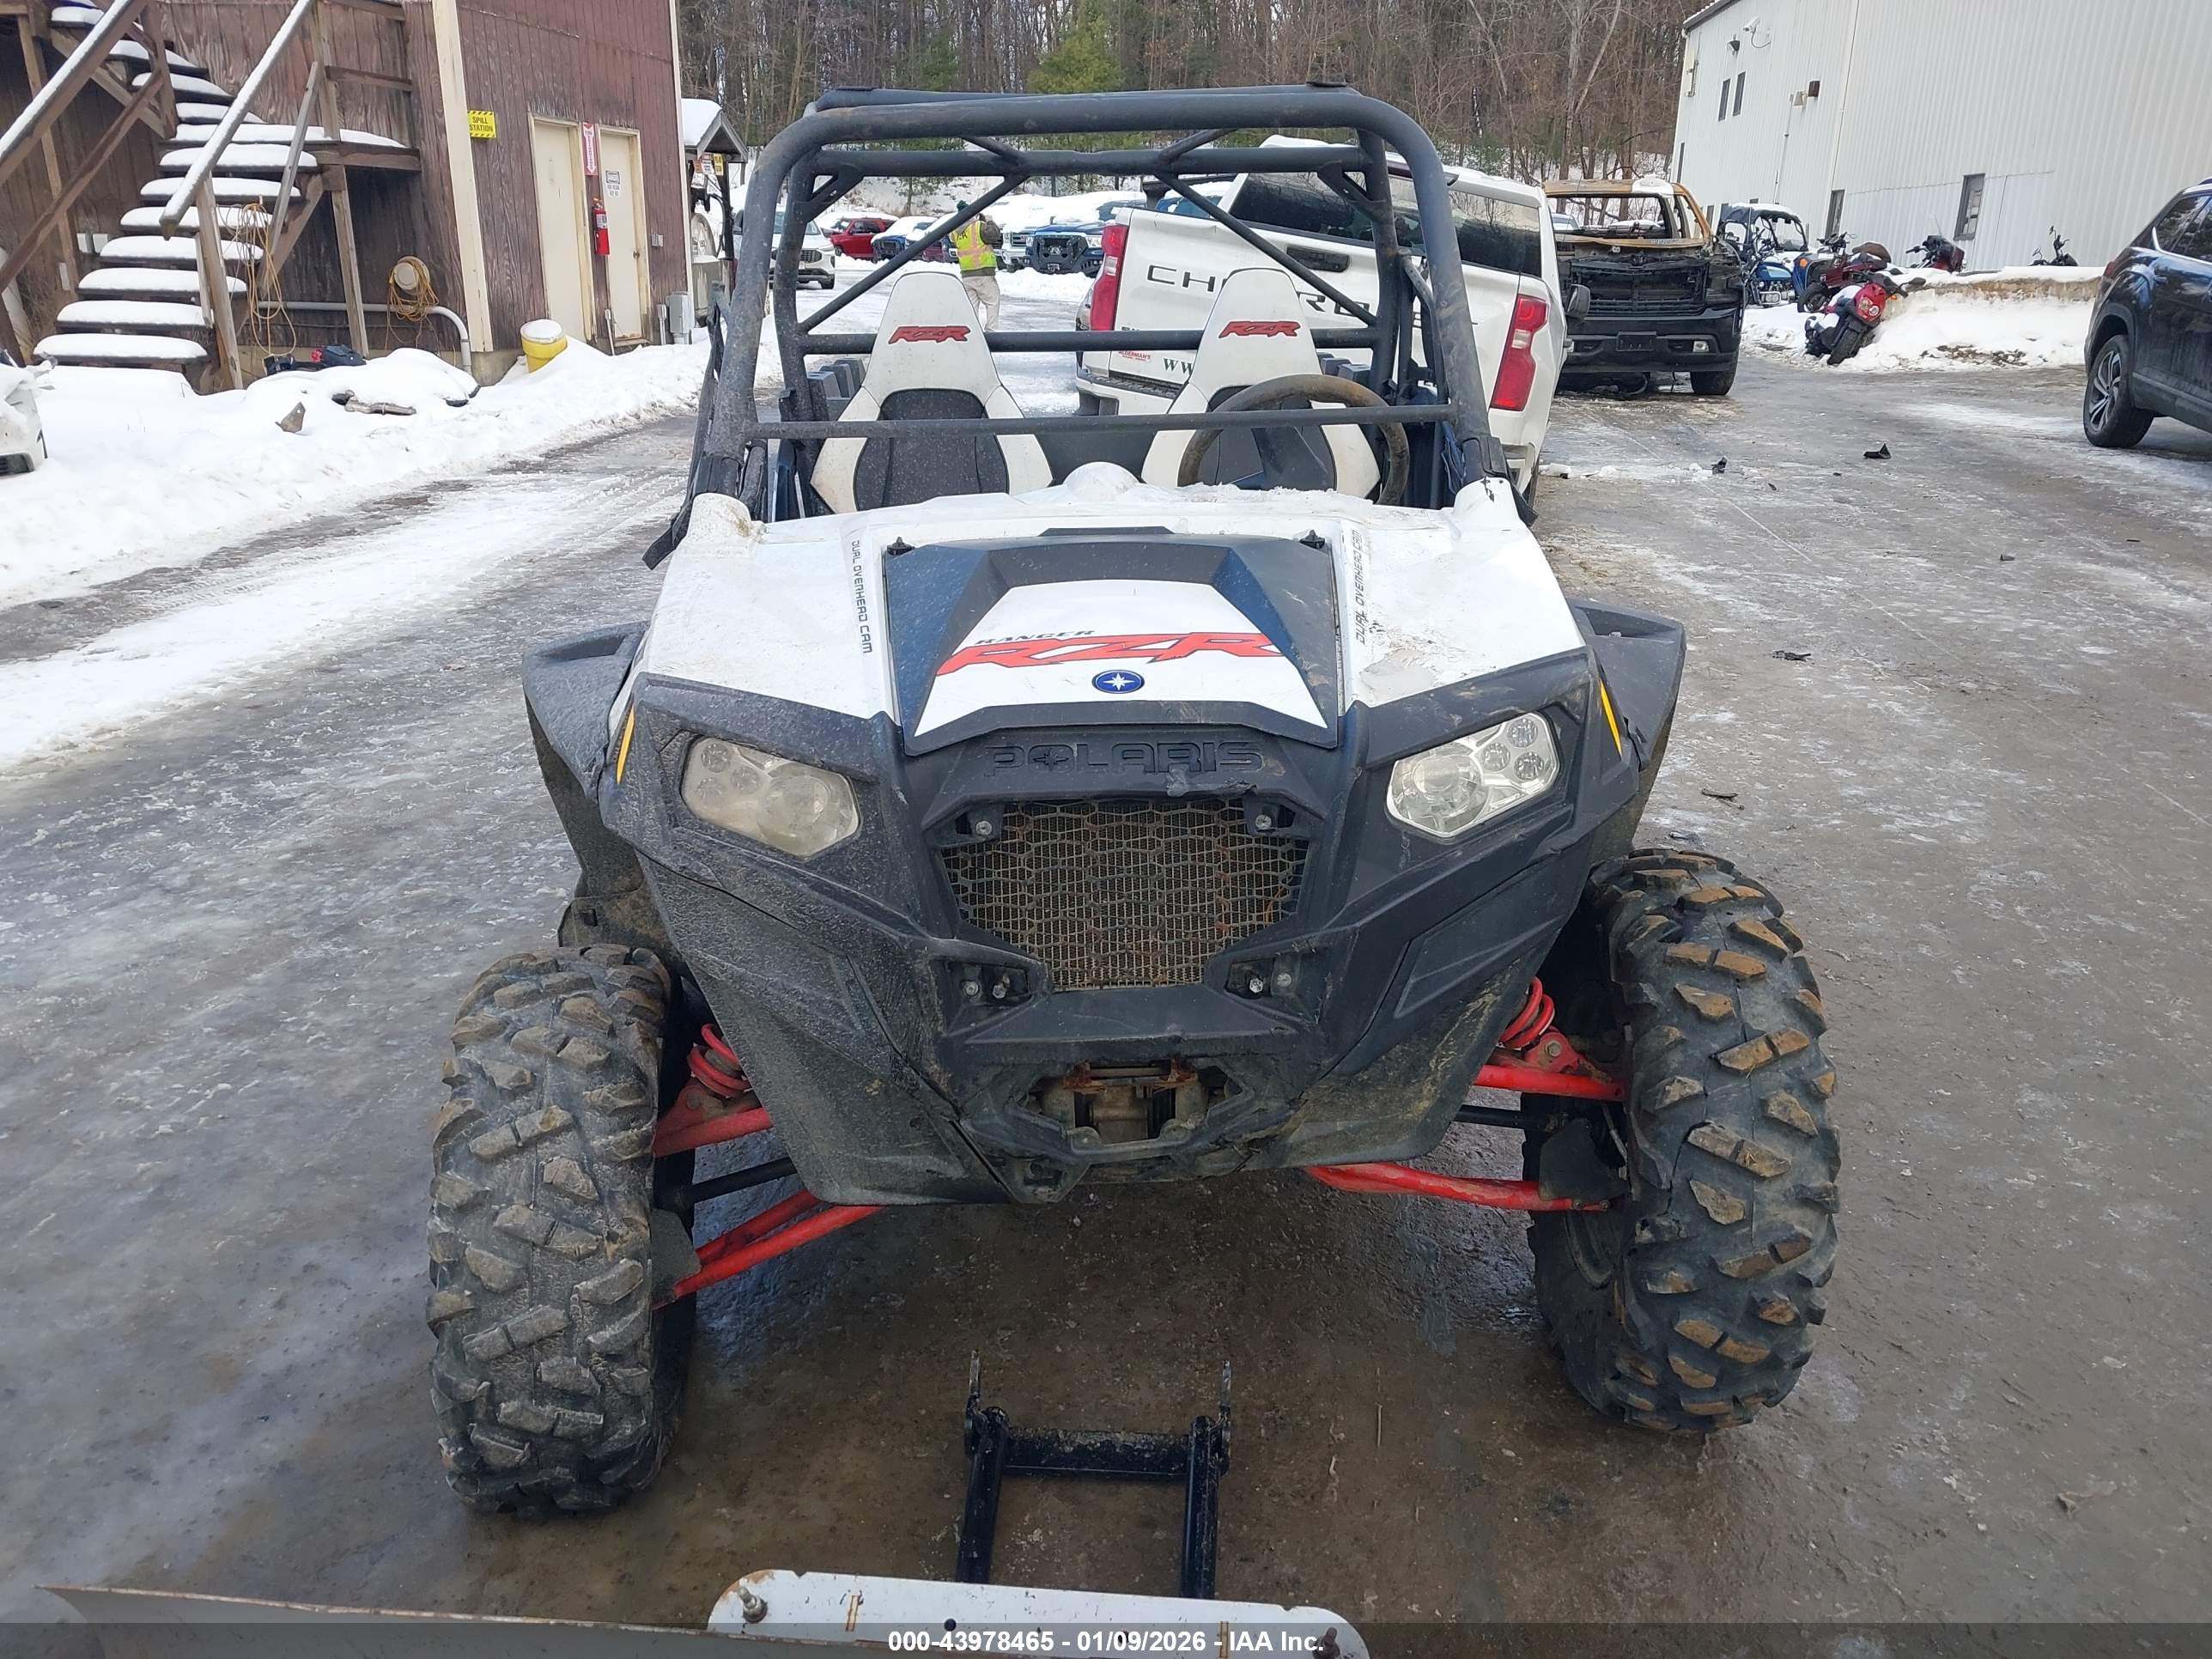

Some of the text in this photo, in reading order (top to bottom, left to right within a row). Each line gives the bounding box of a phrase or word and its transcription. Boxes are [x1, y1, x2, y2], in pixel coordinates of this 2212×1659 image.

[889, 325, 970, 344] RZR
[1218, 321, 1301, 338] RZR
[852, 539, 873, 654] DUAL OVERHEAD CAM
[1353, 552, 1364, 606] OVERHEAD
[975, 629, 1095, 645] RANGER
[1355, 611, 1368, 646] DUAL
[936, 631, 1288, 677] RZR
[984, 741, 1266, 777] POLARIS
